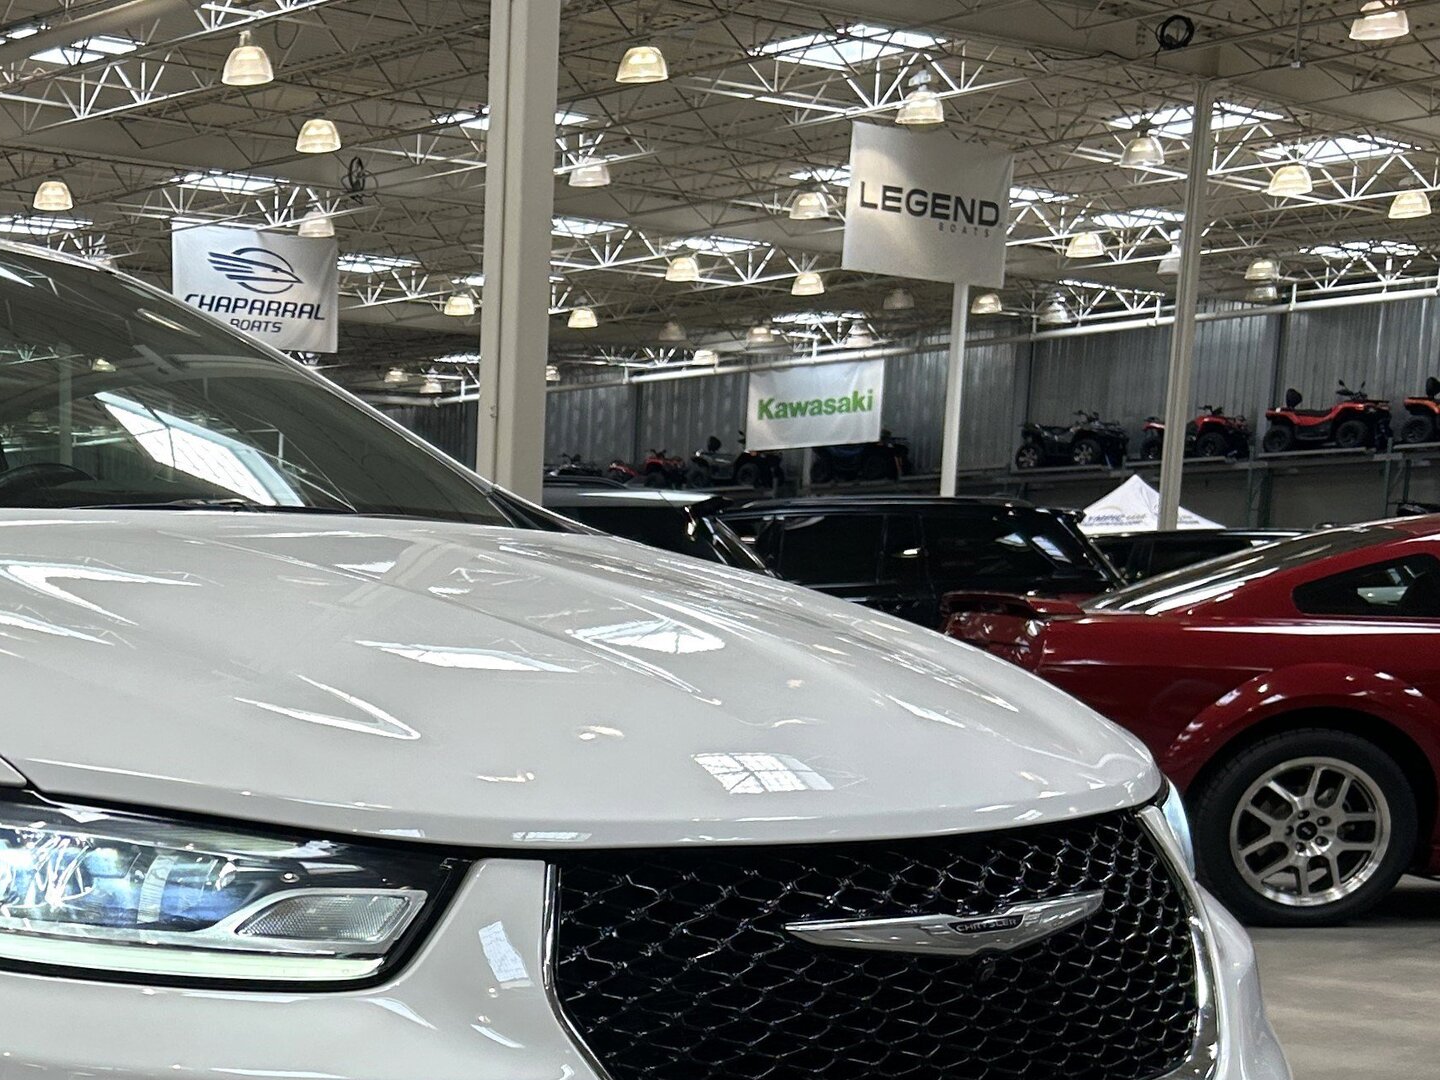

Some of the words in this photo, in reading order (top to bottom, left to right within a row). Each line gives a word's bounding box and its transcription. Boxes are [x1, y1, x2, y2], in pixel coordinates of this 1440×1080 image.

[860, 181, 1000, 227] LEGEND
[938, 222, 991, 238] BOATS
[184, 294, 326, 321] CHAPARRAL
[757, 389, 874, 421] Kawasaki
[955, 918, 1017, 932] CHRYSLER
